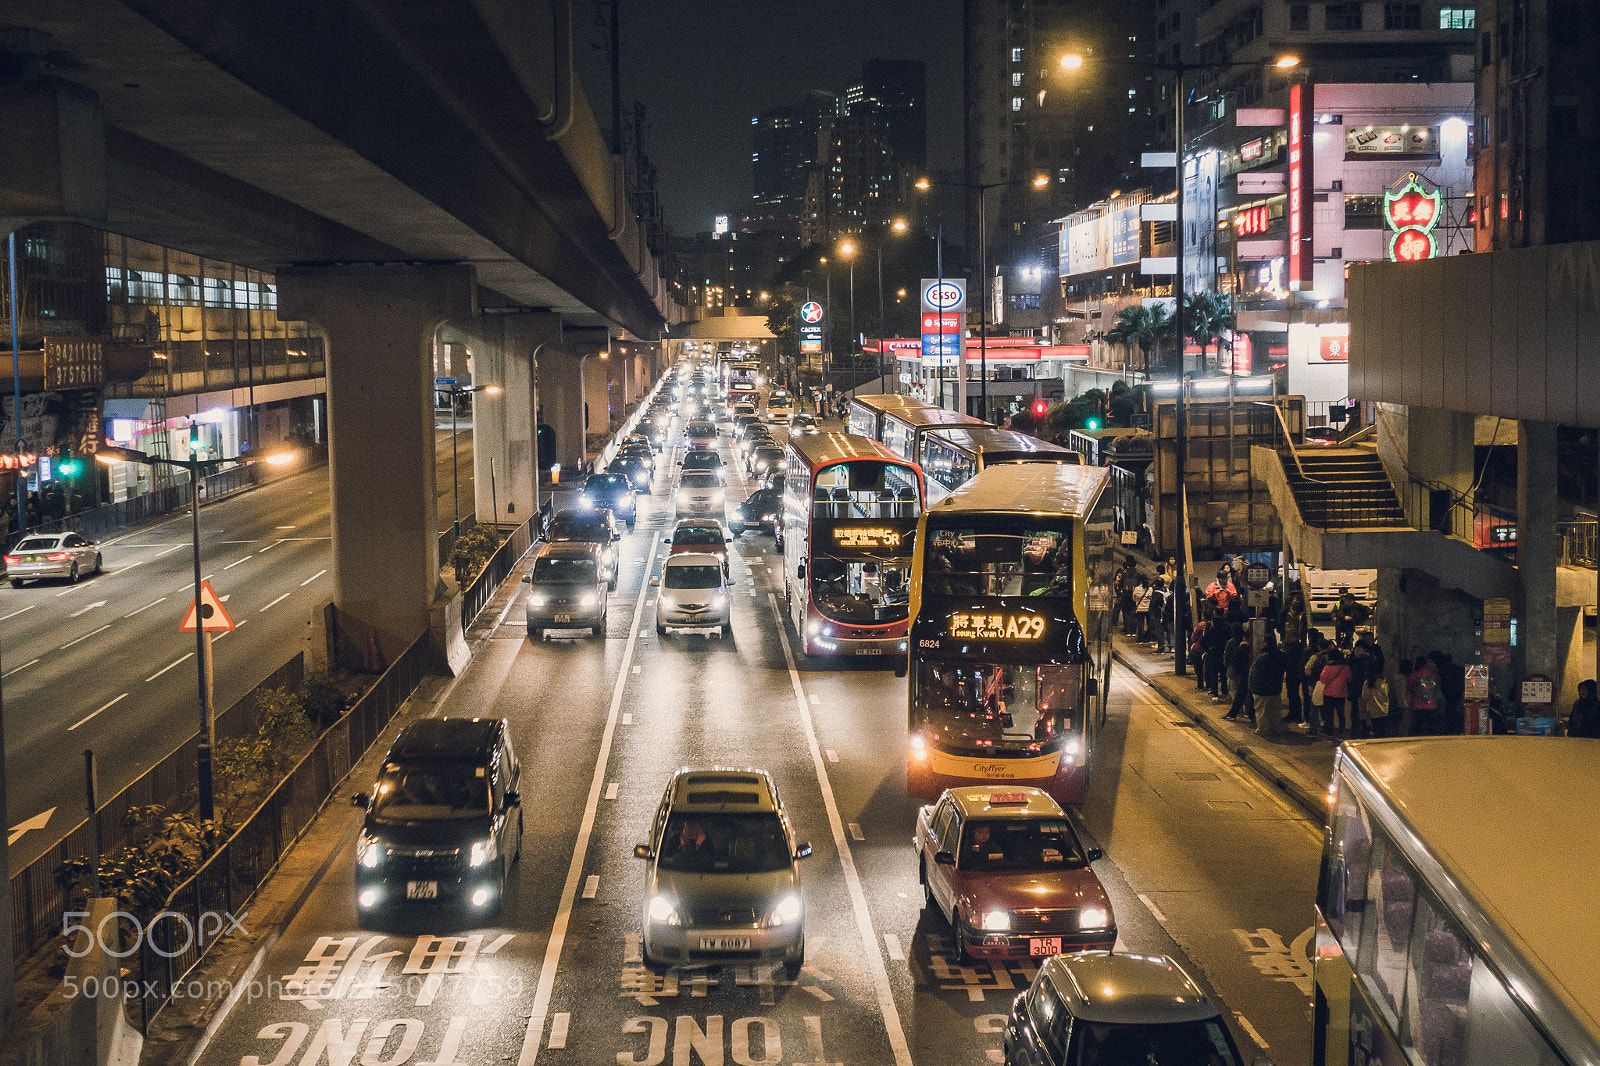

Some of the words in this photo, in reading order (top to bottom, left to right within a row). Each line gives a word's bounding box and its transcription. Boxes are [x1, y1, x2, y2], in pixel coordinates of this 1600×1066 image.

[884, 529, 900, 545] 5R
[1006, 616, 1045, 639] A29
[950, 627, 976, 639] Tseung
[976, 627, 997, 638] Kwan
[919, 640, 940, 649] 6824
[995, 793, 1026, 801] TAXI
[1039, 938, 1053, 947] TR
[1033, 946, 1058, 955] 3010
